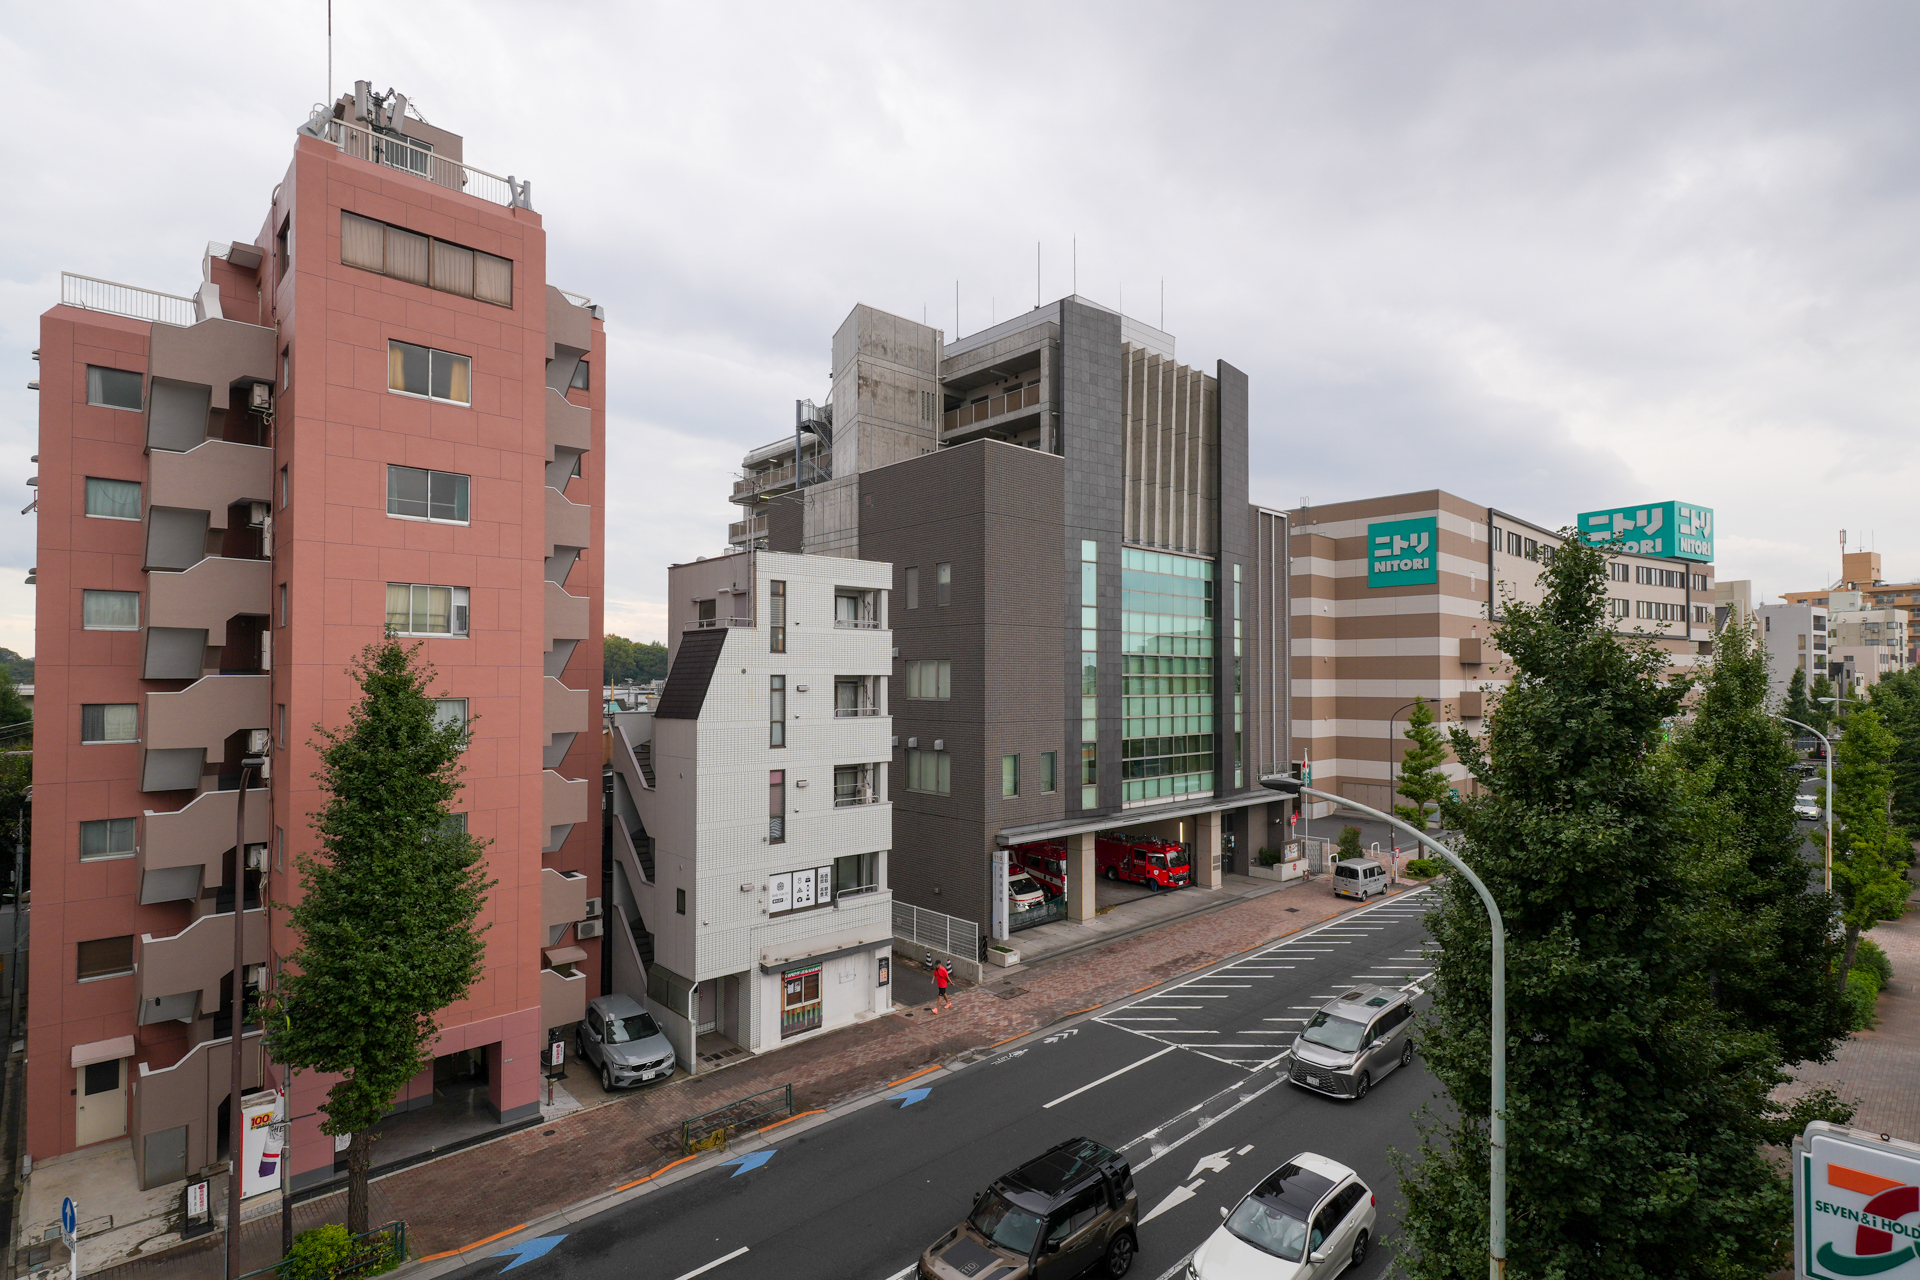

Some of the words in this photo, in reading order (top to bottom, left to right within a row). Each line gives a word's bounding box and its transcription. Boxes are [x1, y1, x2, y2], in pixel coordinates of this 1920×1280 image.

[1588, 507, 1663, 541] ニトリ
[1680, 507, 1711, 538] ニトリ
[1374, 532, 1429, 558] ニトリ
[1590, 538, 1663, 554] ORI
[1680, 537, 1711, 556] NITORI
[1374, 557, 1429, 573] NITORI
[251, 1114, 270, 1127] 100
[1881, 1218, 1920, 1239] HOLD
[961, 1262, 977, 1274] 110
